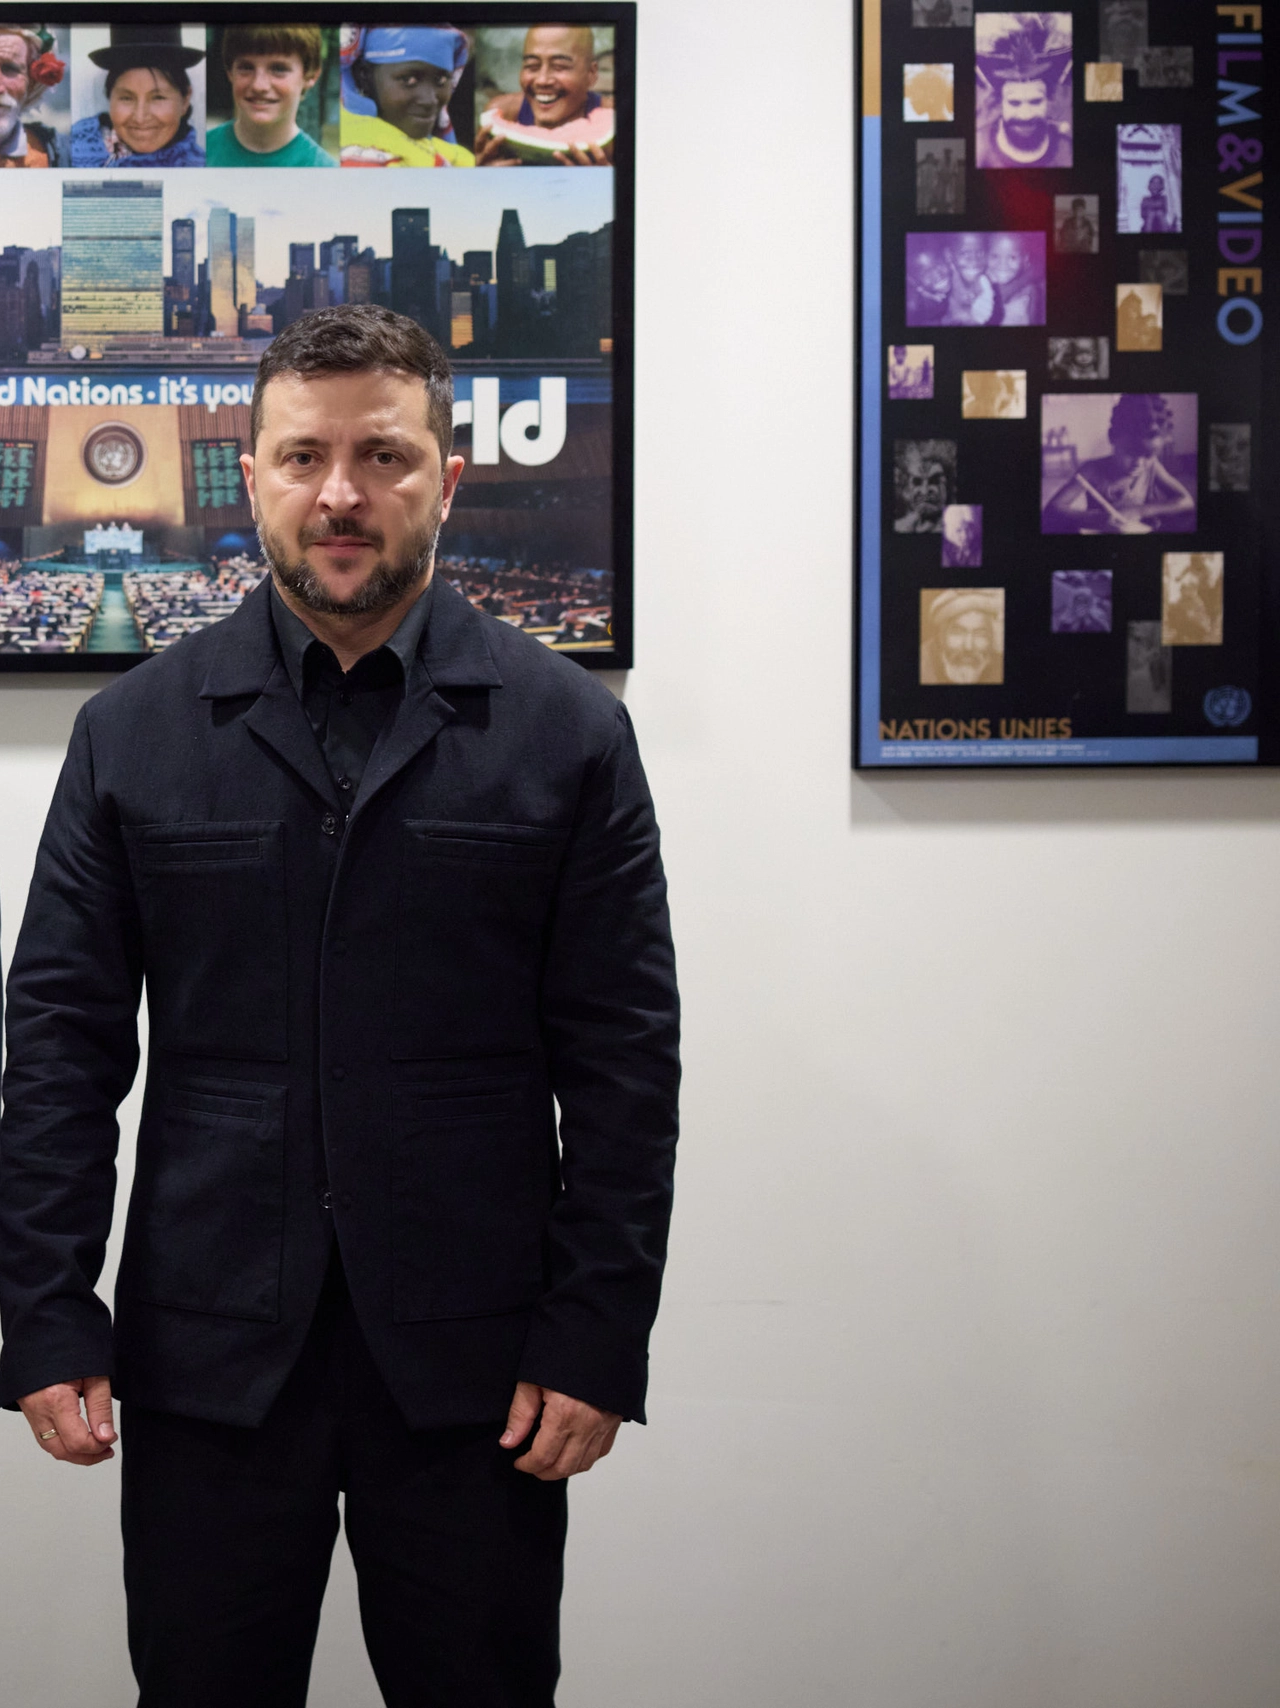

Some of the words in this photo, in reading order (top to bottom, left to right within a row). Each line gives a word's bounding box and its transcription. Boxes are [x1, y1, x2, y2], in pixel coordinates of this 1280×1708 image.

[22, 376, 144, 406] Nations
[158, 376, 199, 406] it's
[878, 717, 992, 741] NATIONS
[999, 716, 1073, 740] UNIES
